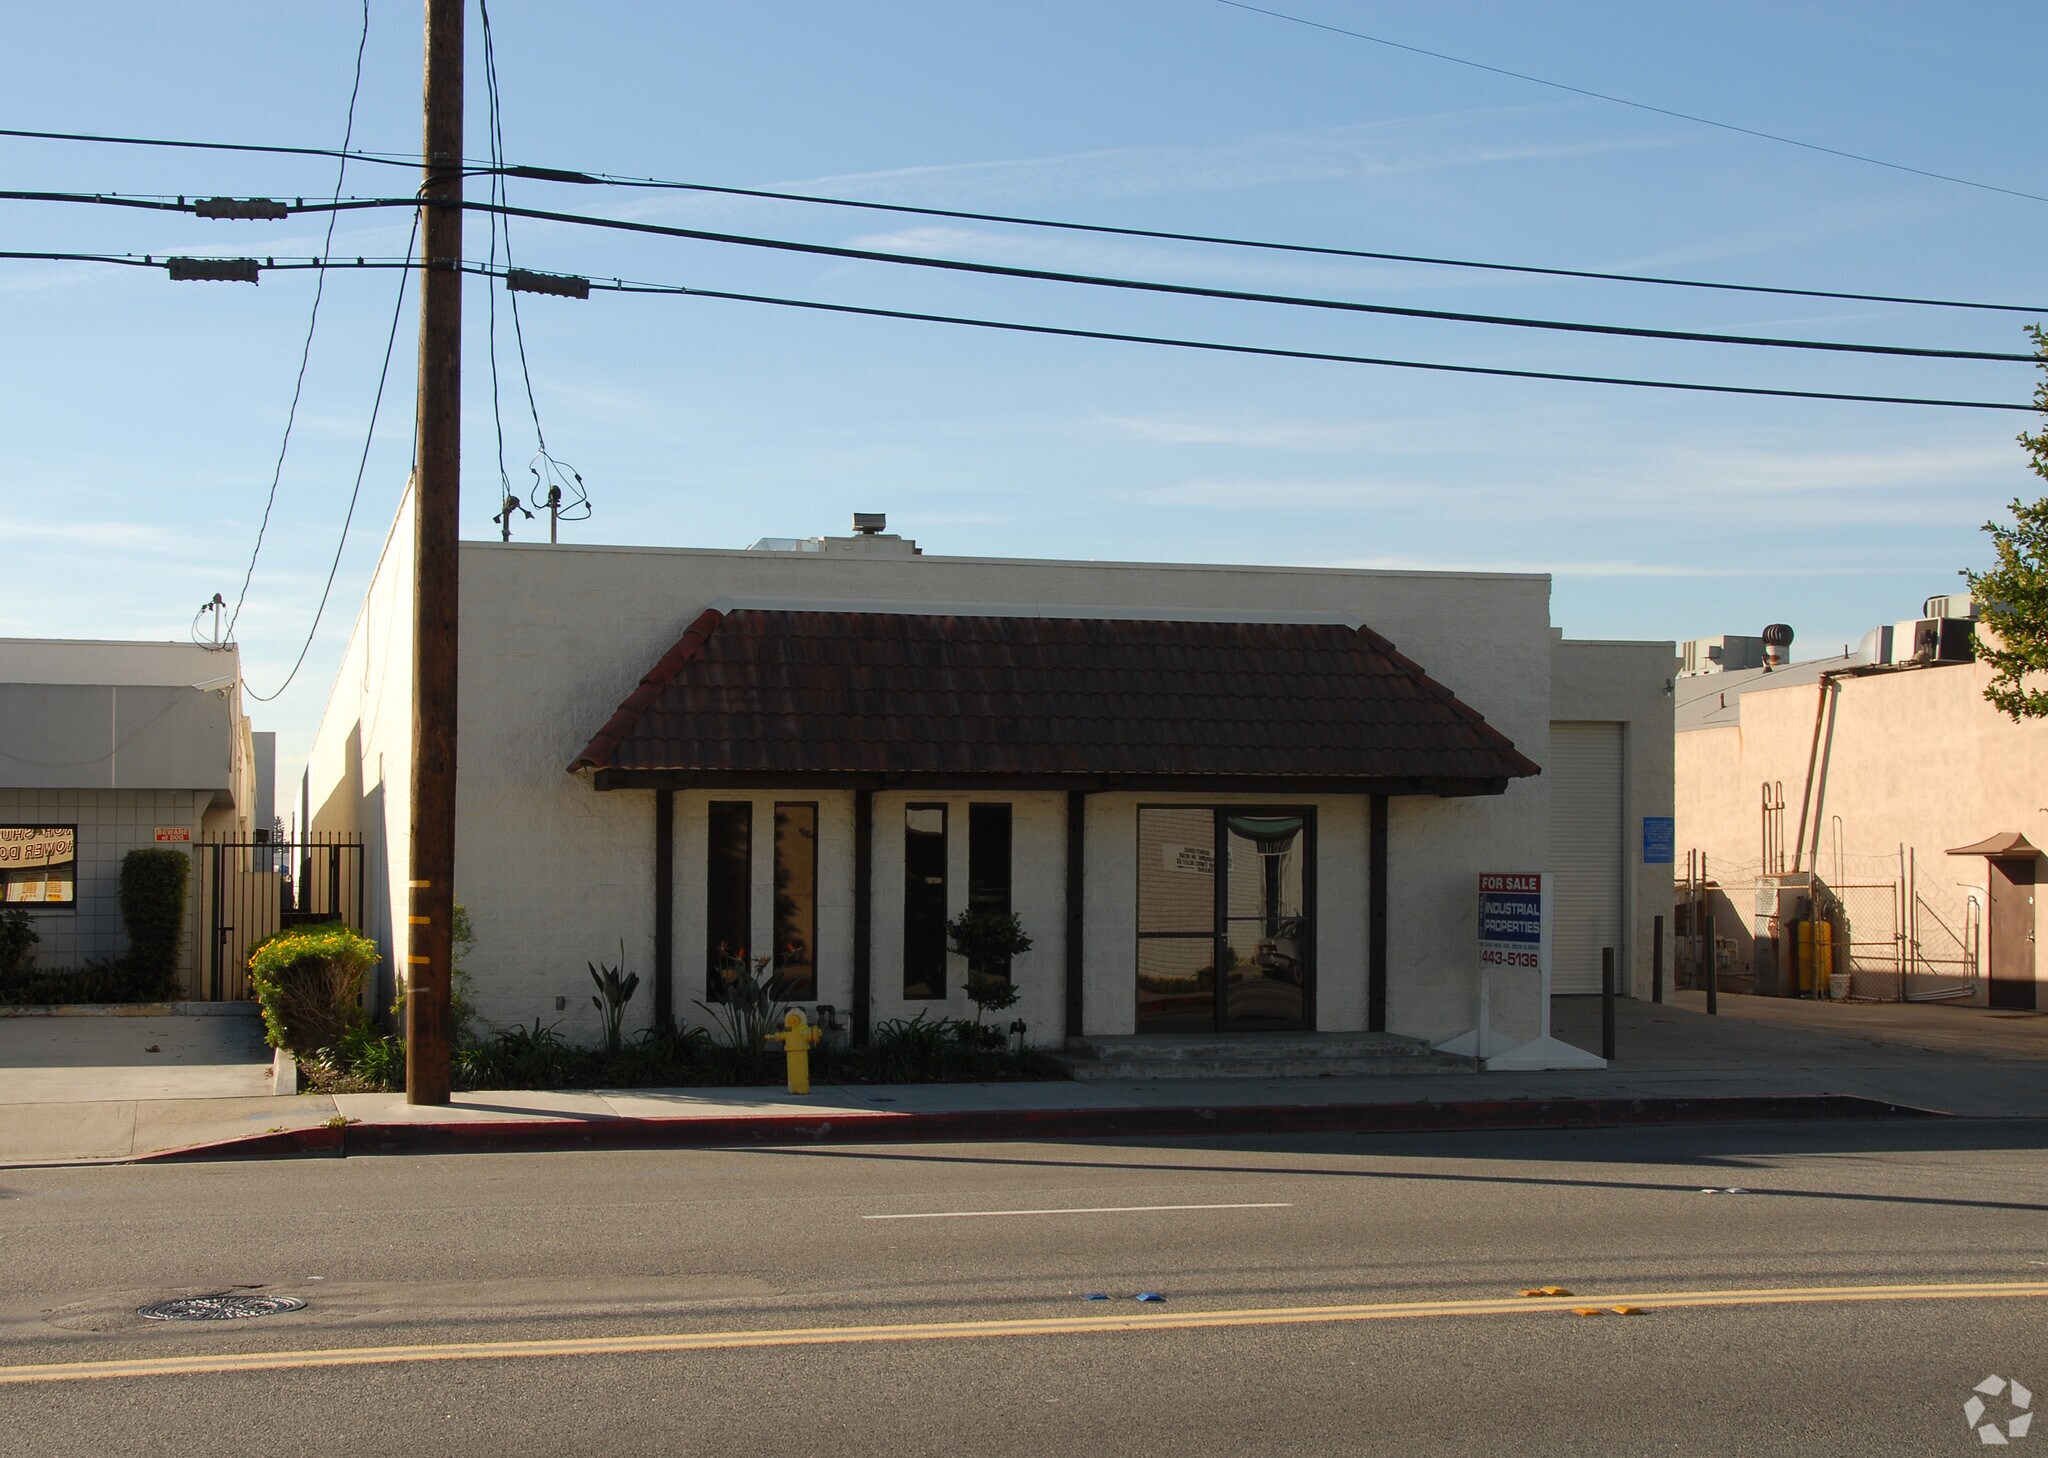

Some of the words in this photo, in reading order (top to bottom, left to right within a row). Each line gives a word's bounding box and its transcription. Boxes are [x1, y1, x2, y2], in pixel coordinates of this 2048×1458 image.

[1482, 877, 1503, 889] FOR
[1506, 878, 1537, 890] SALE
[1486, 902, 1539, 915] INDUSTRIAL
[1485, 919, 1539, 933] PROPERTIES
[1482, 950, 1538, 968] 443-5136
